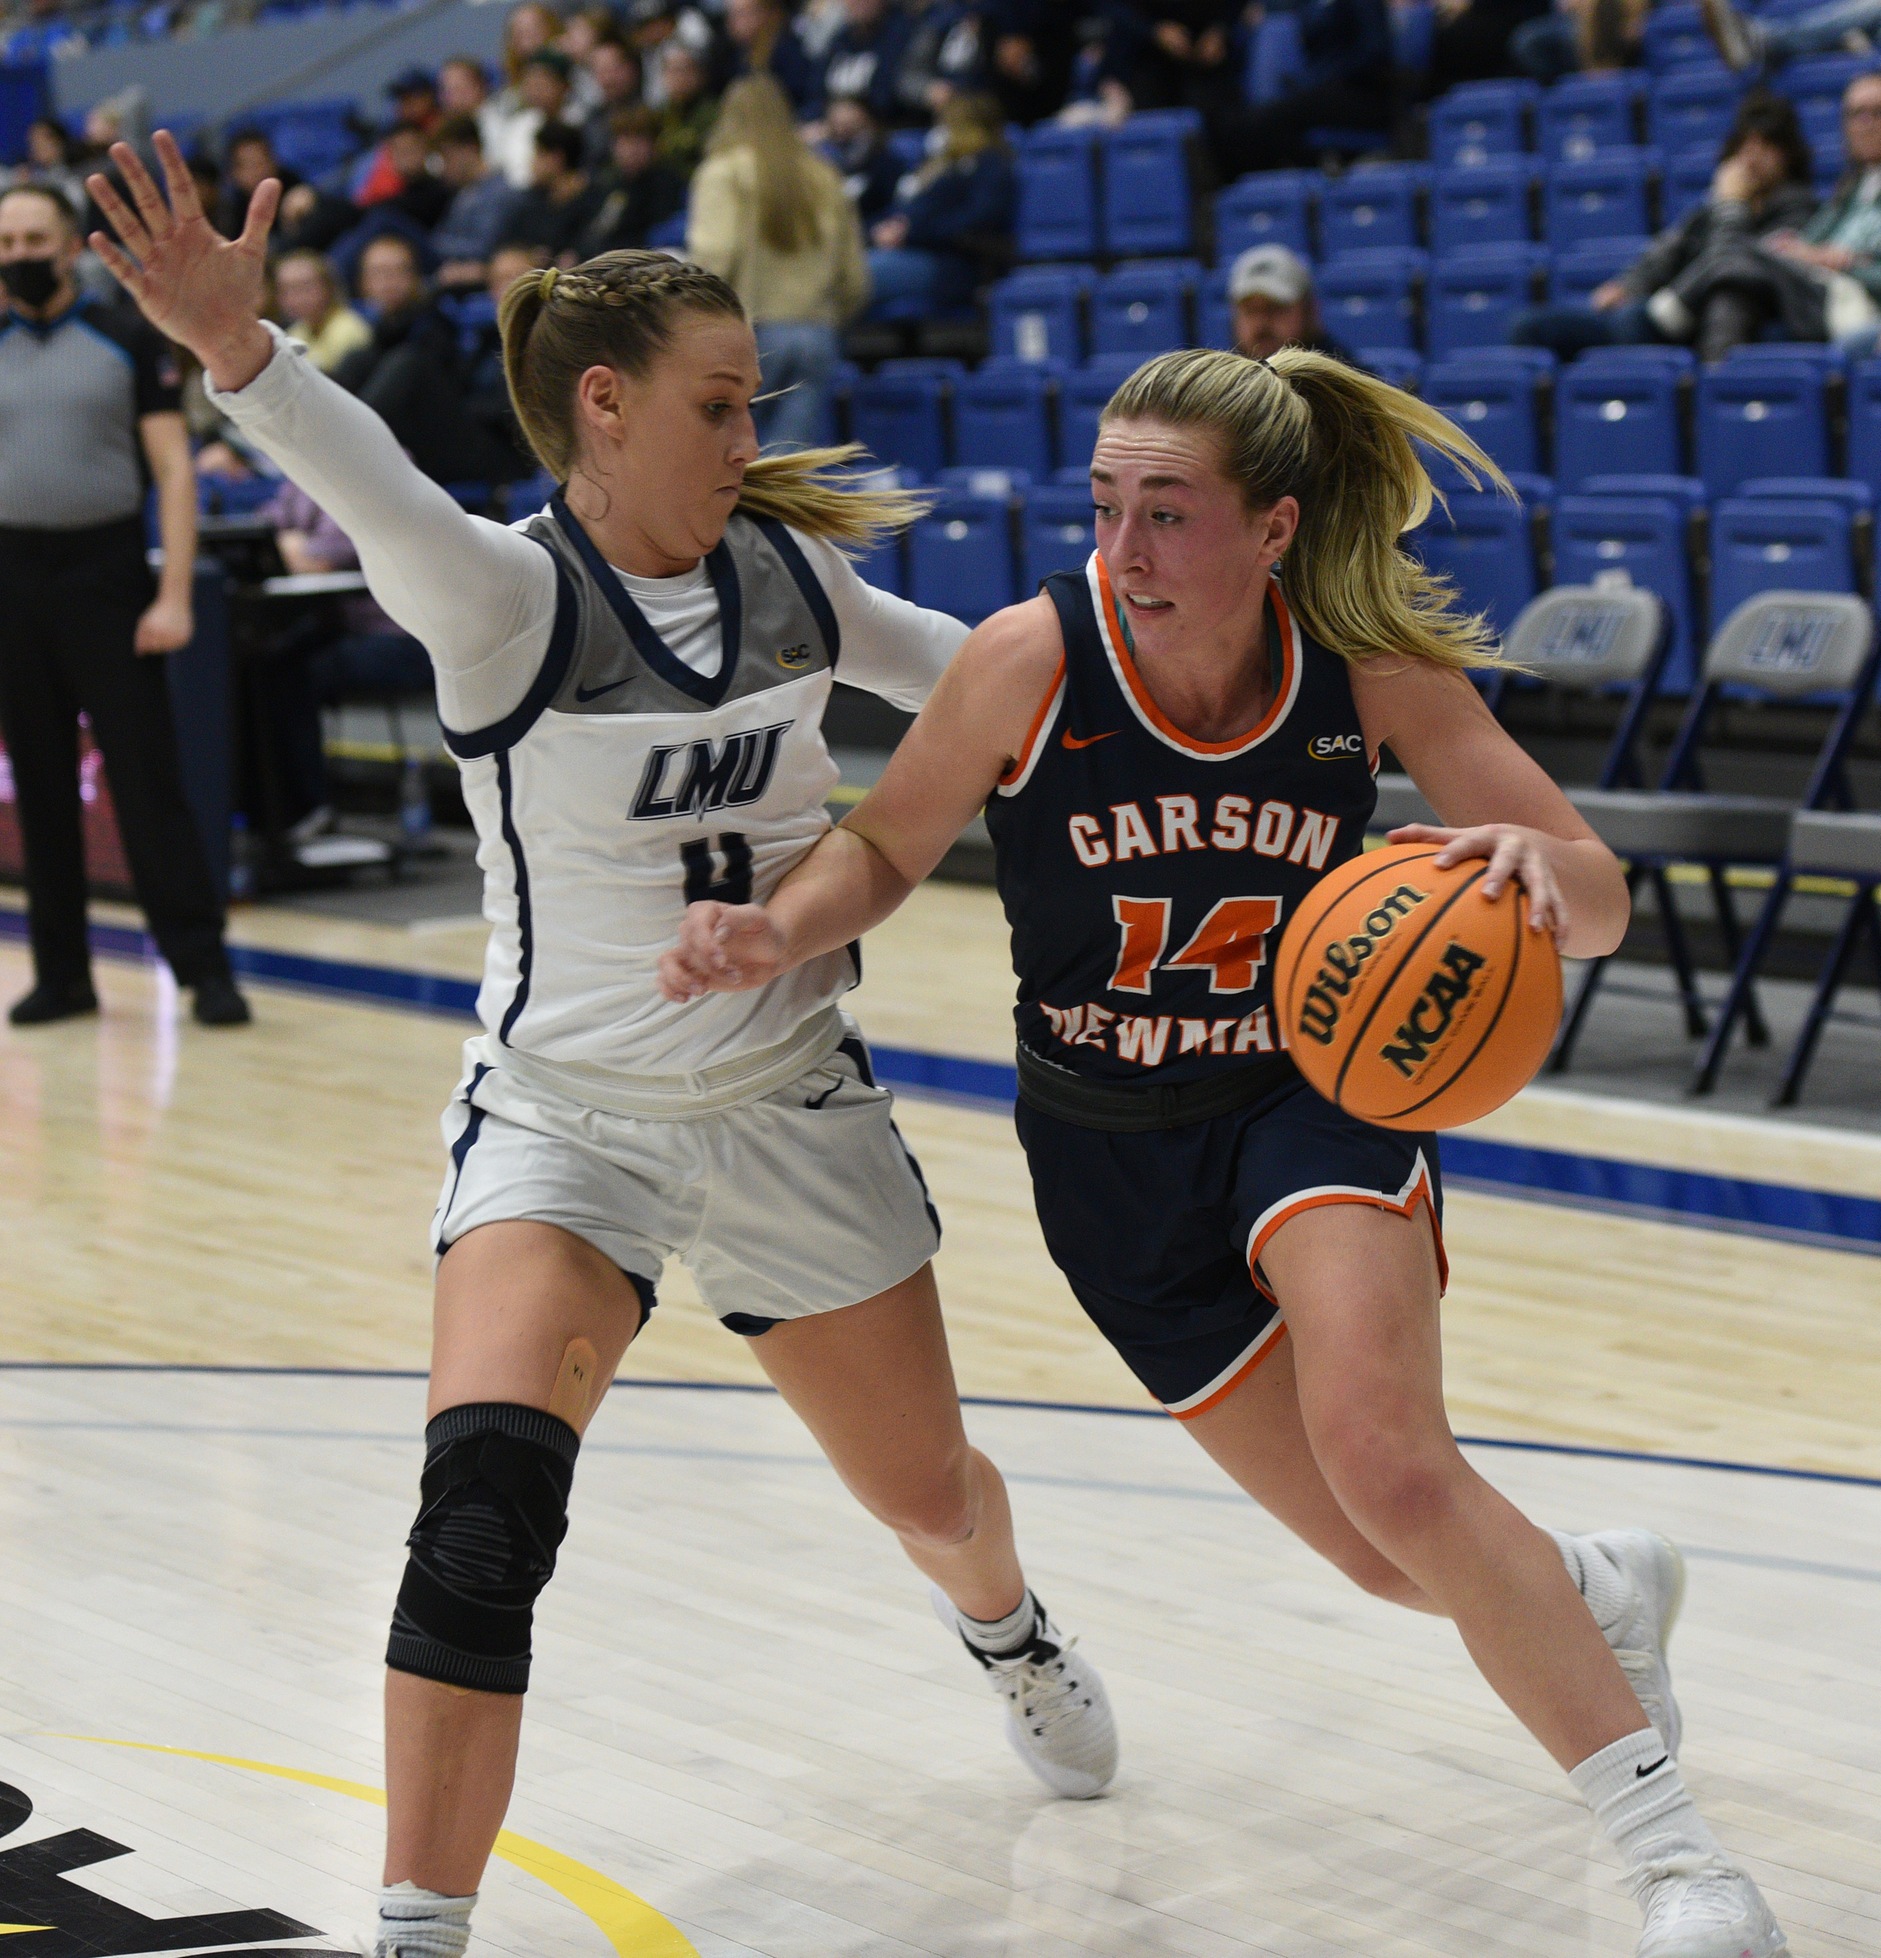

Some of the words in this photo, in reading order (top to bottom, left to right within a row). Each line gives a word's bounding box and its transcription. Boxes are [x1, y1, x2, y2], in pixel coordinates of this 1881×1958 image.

[626, 719, 796, 823] LMU
[1316, 735, 1362, 754] SAC
[1068, 794, 1340, 870] CARSON
[1106, 894, 1283, 996] 14
[1299, 883, 1431, 1046] Wilson
[1039, 1001, 1290, 1067] NEWMA
[1378, 939, 1486, 1081] NCAA
